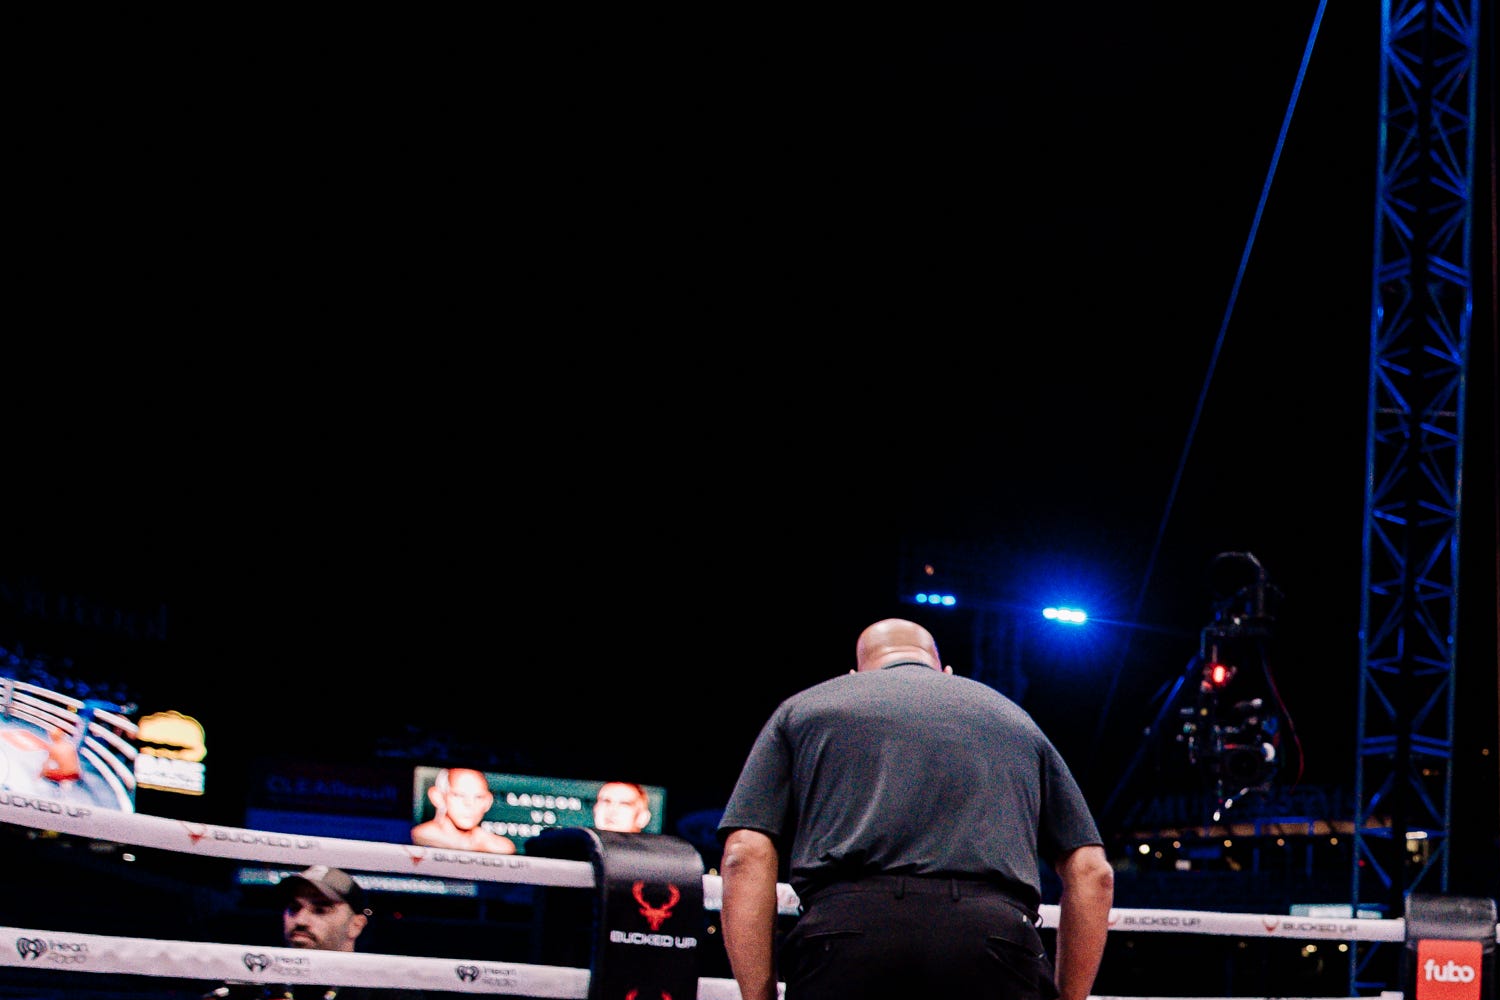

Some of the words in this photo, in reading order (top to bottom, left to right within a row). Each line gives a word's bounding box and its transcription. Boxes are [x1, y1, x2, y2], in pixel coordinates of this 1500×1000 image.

[0, 795, 62, 814] UCKED
[1124, 916, 1178, 927] BUCKED
[1283, 922, 1337, 933] BUCKED
[610, 929, 674, 947] BUCKED
[675, 935, 697, 949] UP
[1424, 959, 1475, 983] fubo
